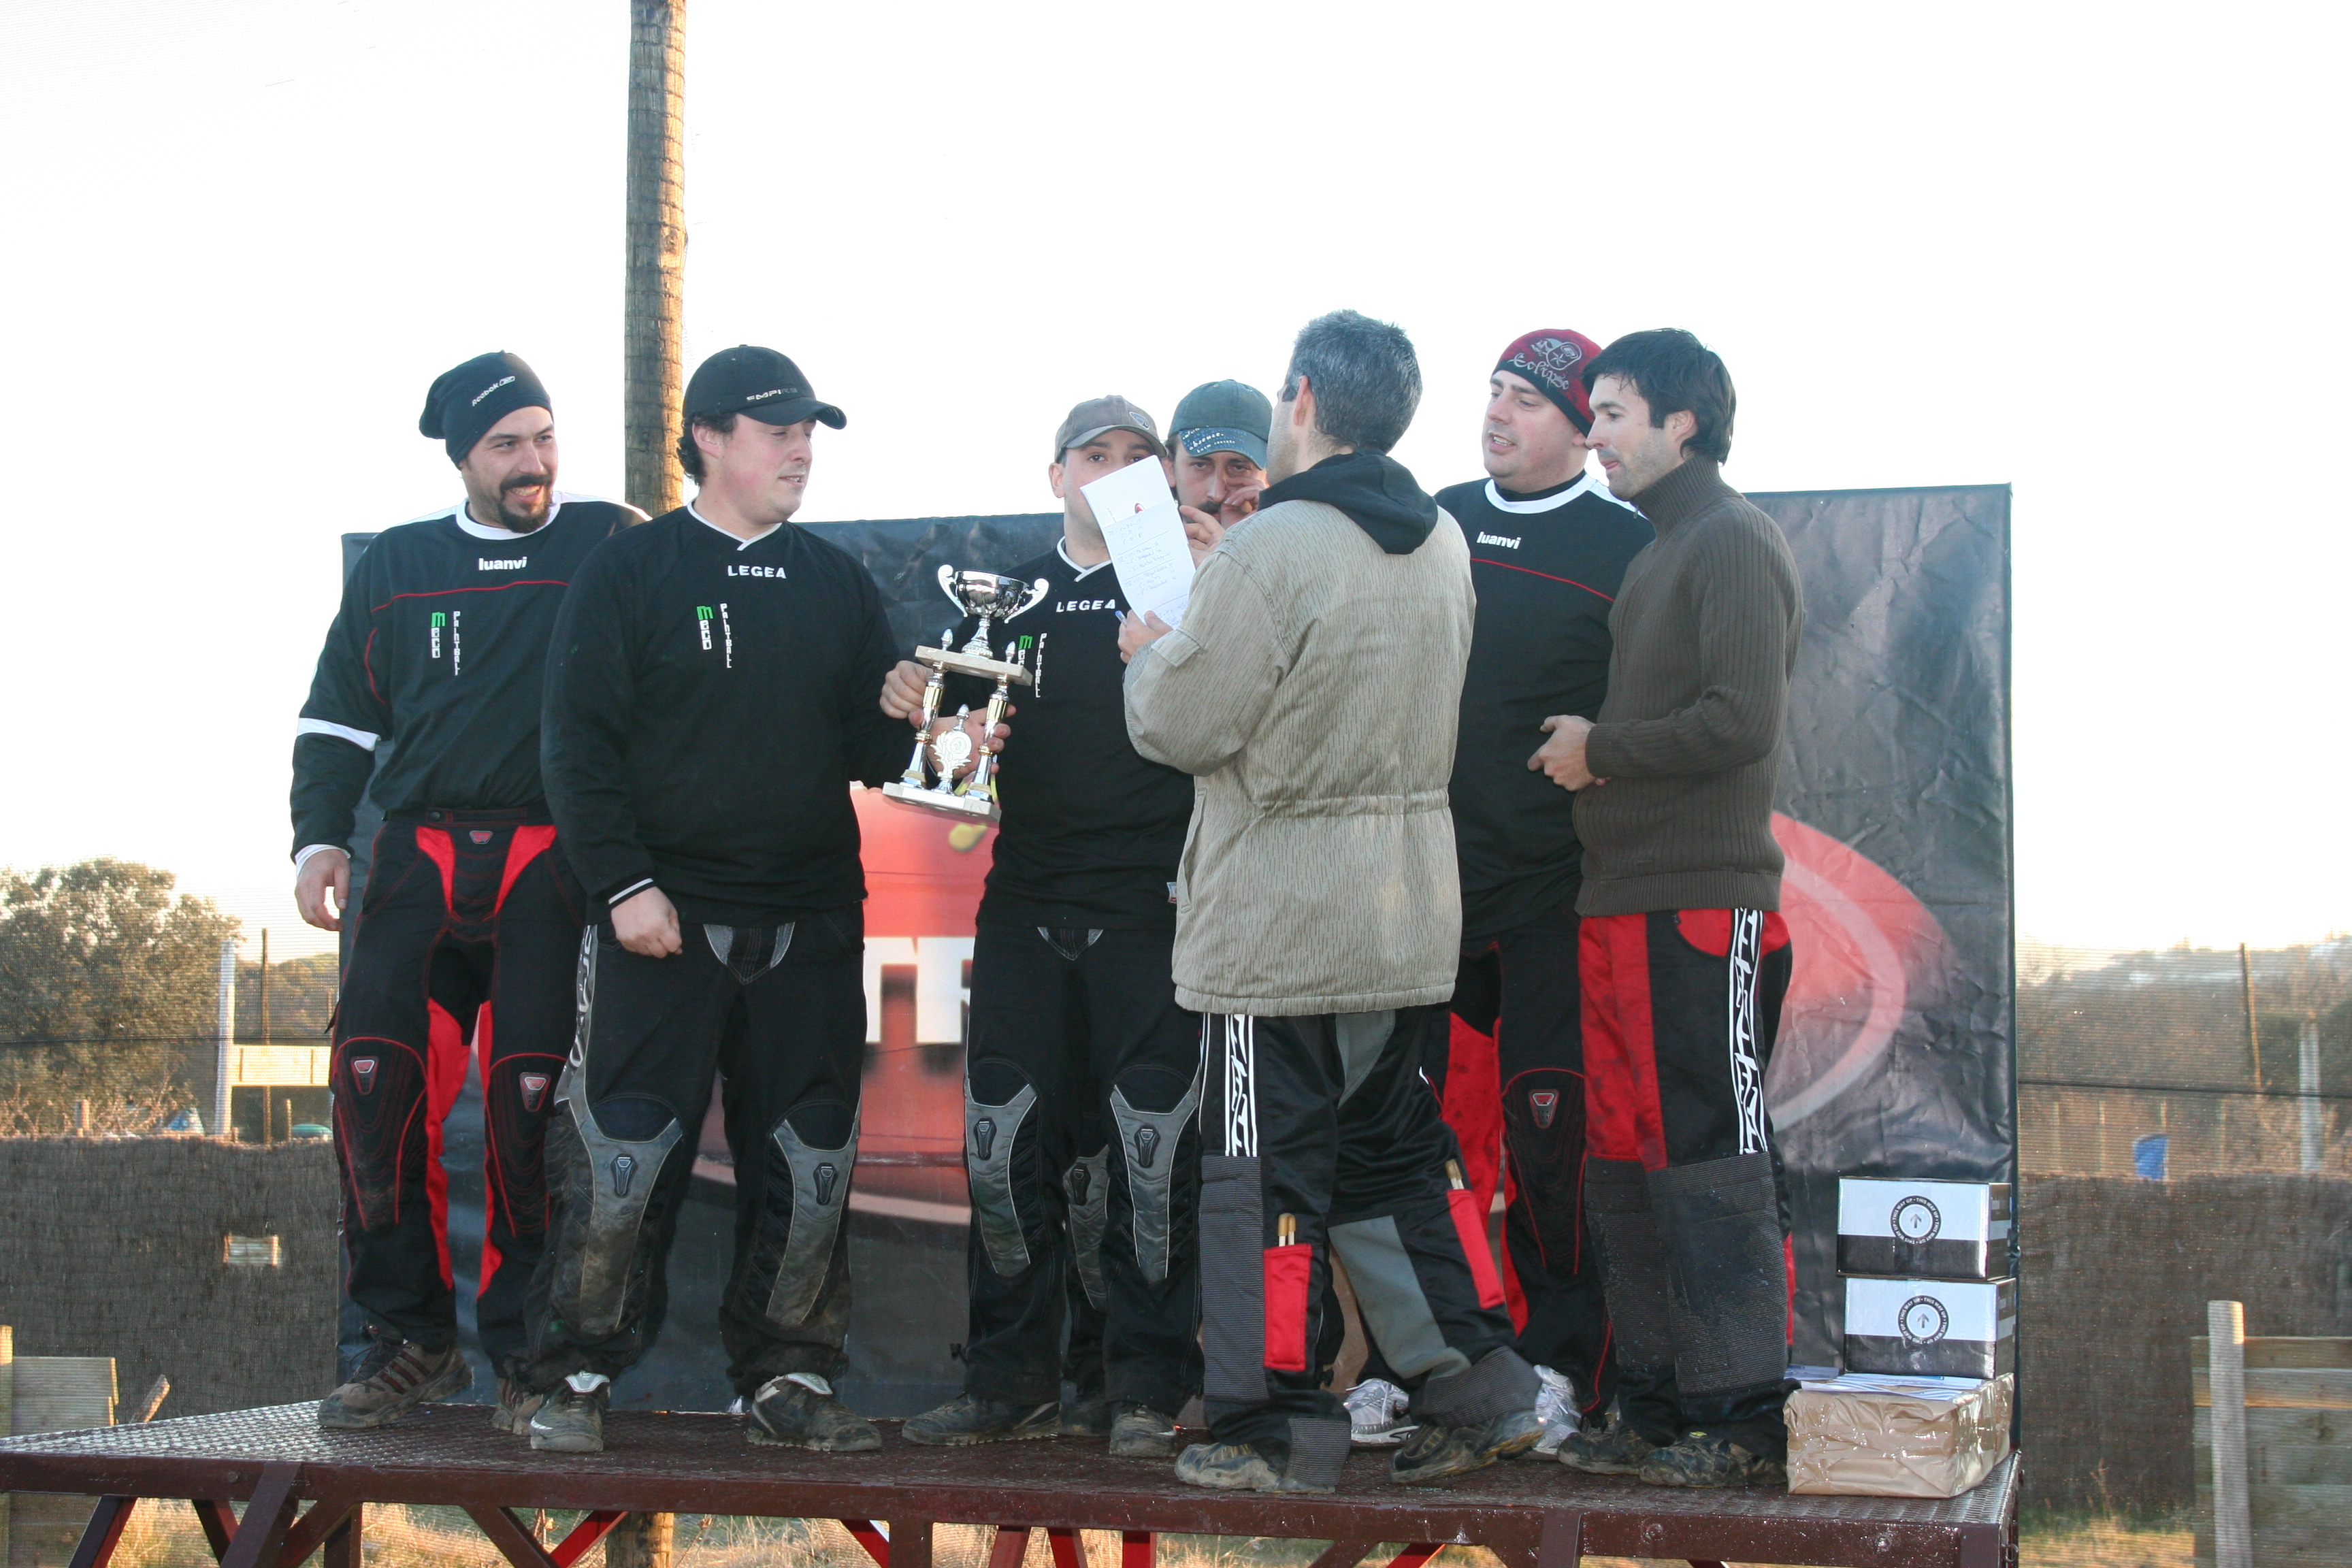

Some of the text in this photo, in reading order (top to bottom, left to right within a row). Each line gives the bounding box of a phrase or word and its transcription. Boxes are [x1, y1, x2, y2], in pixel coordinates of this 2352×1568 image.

[472, 382, 500, 407] Reebok
[1476, 531, 1522, 549] luanvi
[478, 556, 527, 571] luanvi
[728, 565, 787, 579] LEGEA
[1056, 599, 1116, 612] LEGEA
